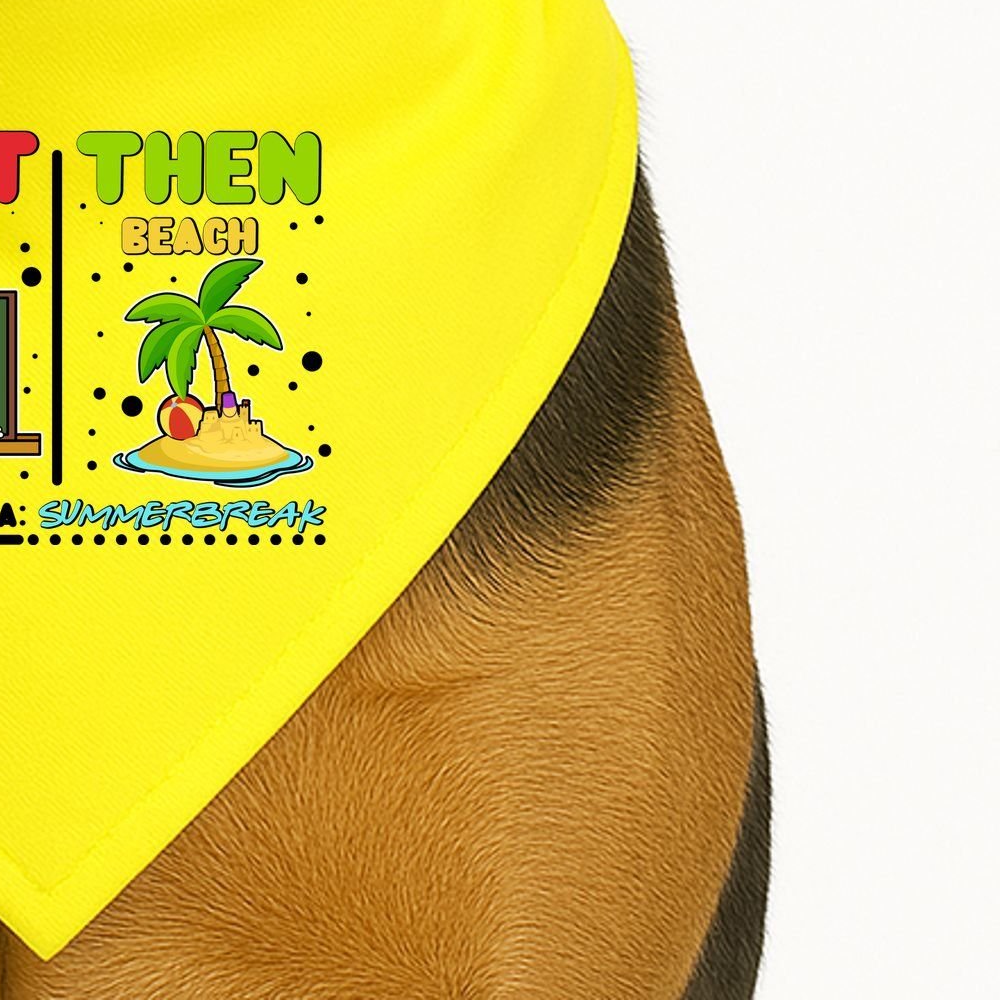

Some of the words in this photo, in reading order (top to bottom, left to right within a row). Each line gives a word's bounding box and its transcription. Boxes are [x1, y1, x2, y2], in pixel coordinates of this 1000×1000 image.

[76, 130, 322, 205] THEN
[121, 217, 259, 255] BEACH
[38, 499, 327, 533] SUMMERBREAK
